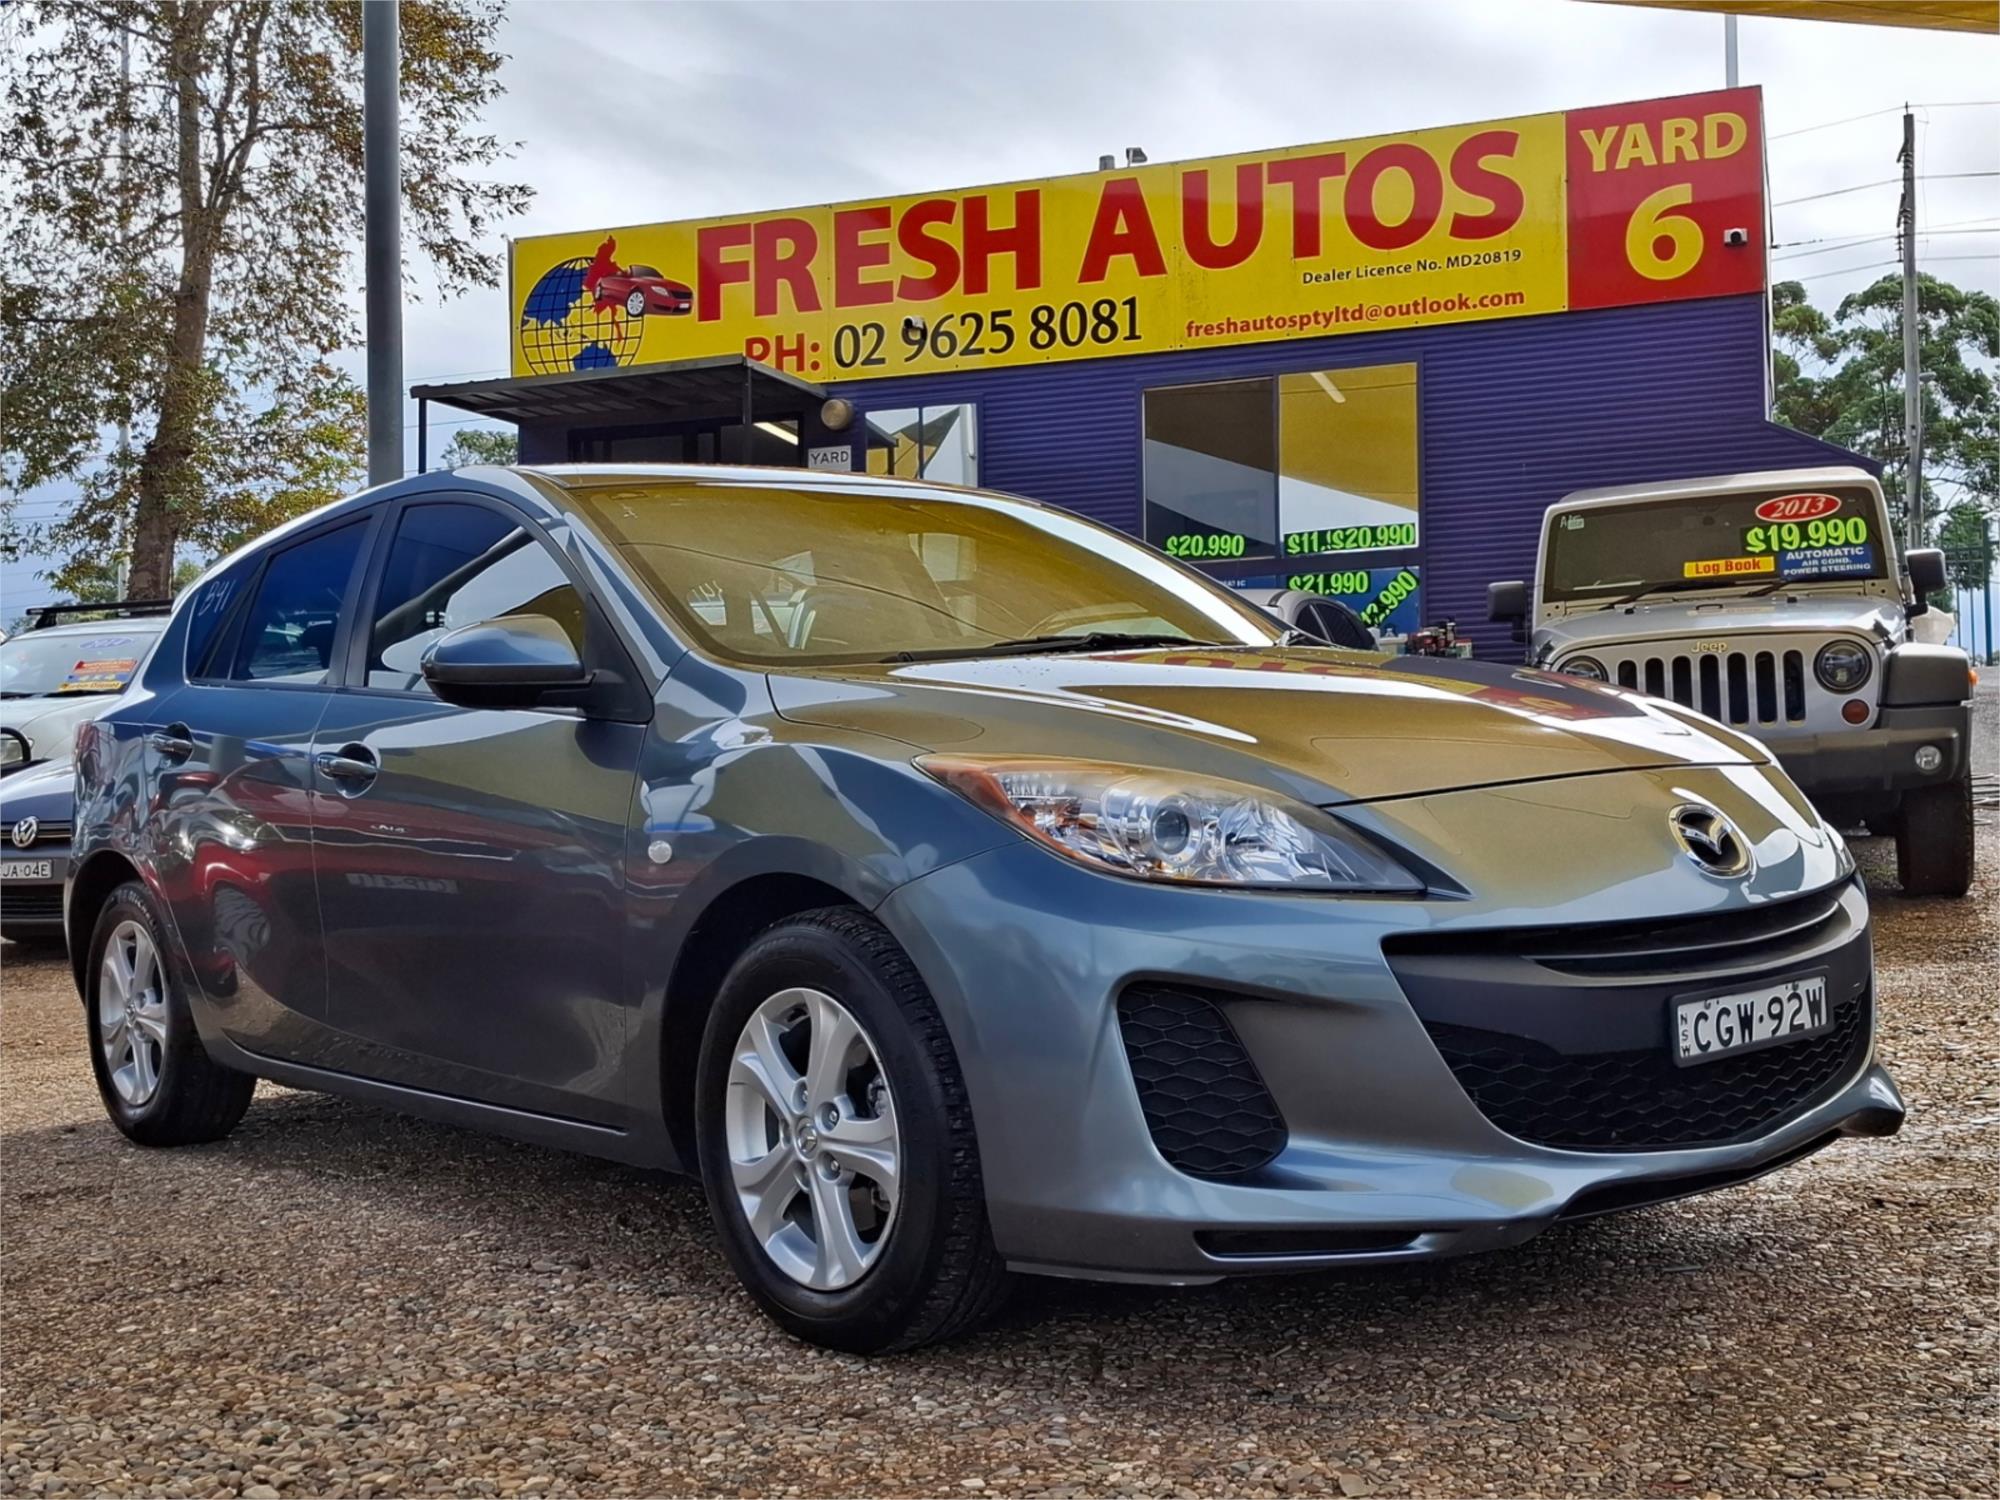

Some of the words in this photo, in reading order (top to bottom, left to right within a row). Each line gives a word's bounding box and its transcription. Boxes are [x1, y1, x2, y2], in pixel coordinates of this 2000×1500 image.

[1579, 112, 1748, 172] YARD
[696, 189, 1041, 322] FRESH
[1078, 130, 1525, 283] AUTOS
[1625, 183, 1704, 280] 6
[1302, 268, 1351, 285] Dealer
[1356, 261, 1412, 279] Licence
[1417, 258, 1442, 272] No.
[1446, 249, 1522, 269] MD20819
[1186, 289, 1525, 338] freshautosptyltd@outlook.com
[746, 333, 821, 371] PH:
[833, 322, 886, 369] 02
[901, 309, 1015, 363] 9625
[1028, 297, 1142, 350] 8081
[811, 450, 849, 465] YARD
[1771, 497, 1826, 518] 2013
[1166, 534, 1245, 558] $20.990
[1332, 524, 1416, 549] $20.990
[1746, 517, 1867, 553] $19.990
[1786, 546, 1864, 560] AUTOMATIC
[1801, 559, 1819, 567] AIR
[1821, 557, 1852, 566] COND.
[1695, 562, 1721, 575] Log
[1724, 558, 1761, 571] Book
[1783, 566, 1819, 576] POWER
[1820, 563, 1871, 573] STEERING
[1691, 641, 1728, 653] Jeep
